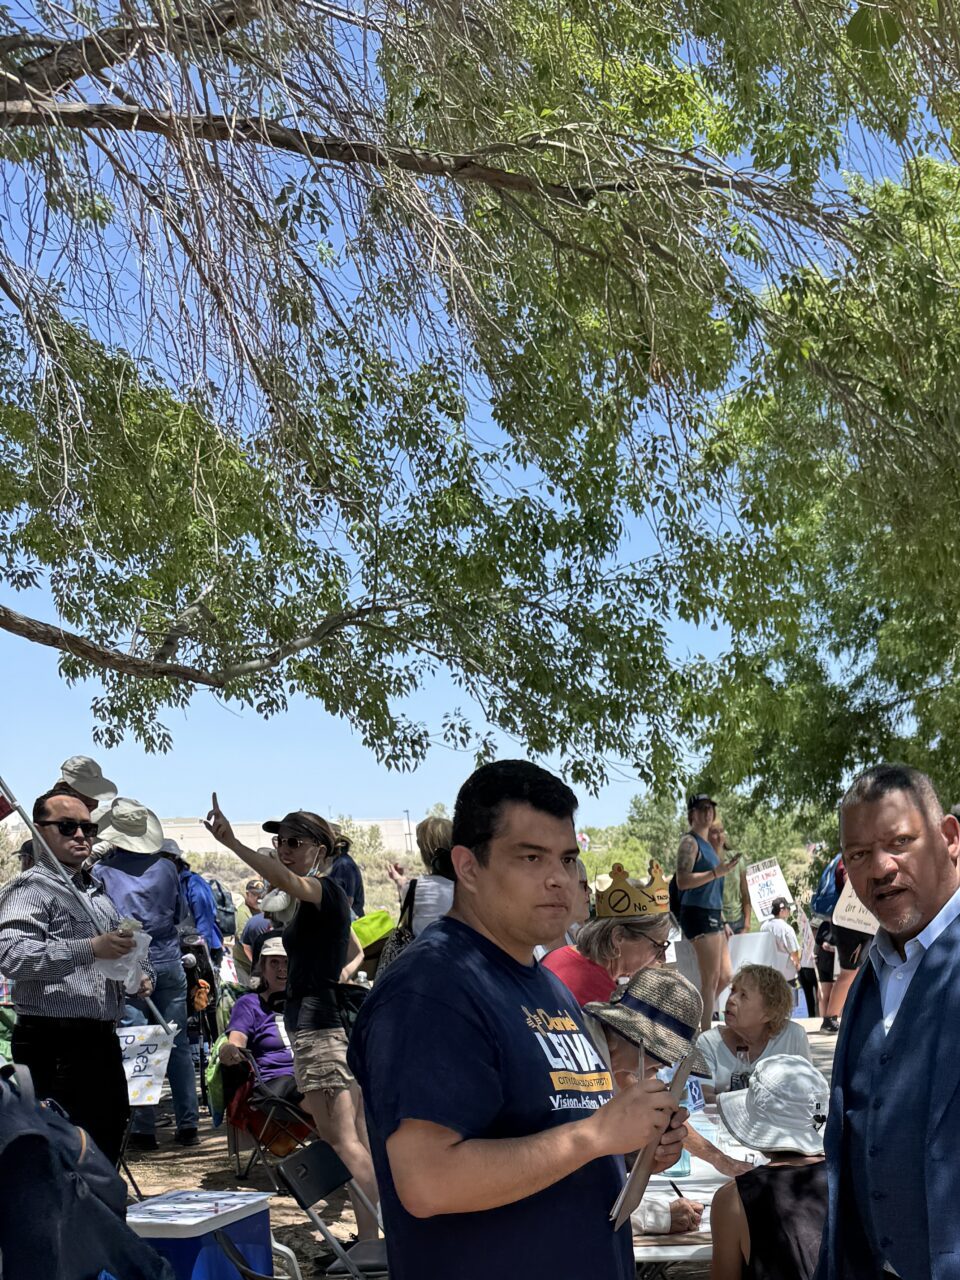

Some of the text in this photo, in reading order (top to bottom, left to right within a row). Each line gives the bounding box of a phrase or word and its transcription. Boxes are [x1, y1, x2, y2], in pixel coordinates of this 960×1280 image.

[633, 903, 648, 912] No
[536, 1008, 580, 1031] Daniel
[130, 1043, 158, 1079] Real
[534, 1032, 606, 1072] LEIVA
